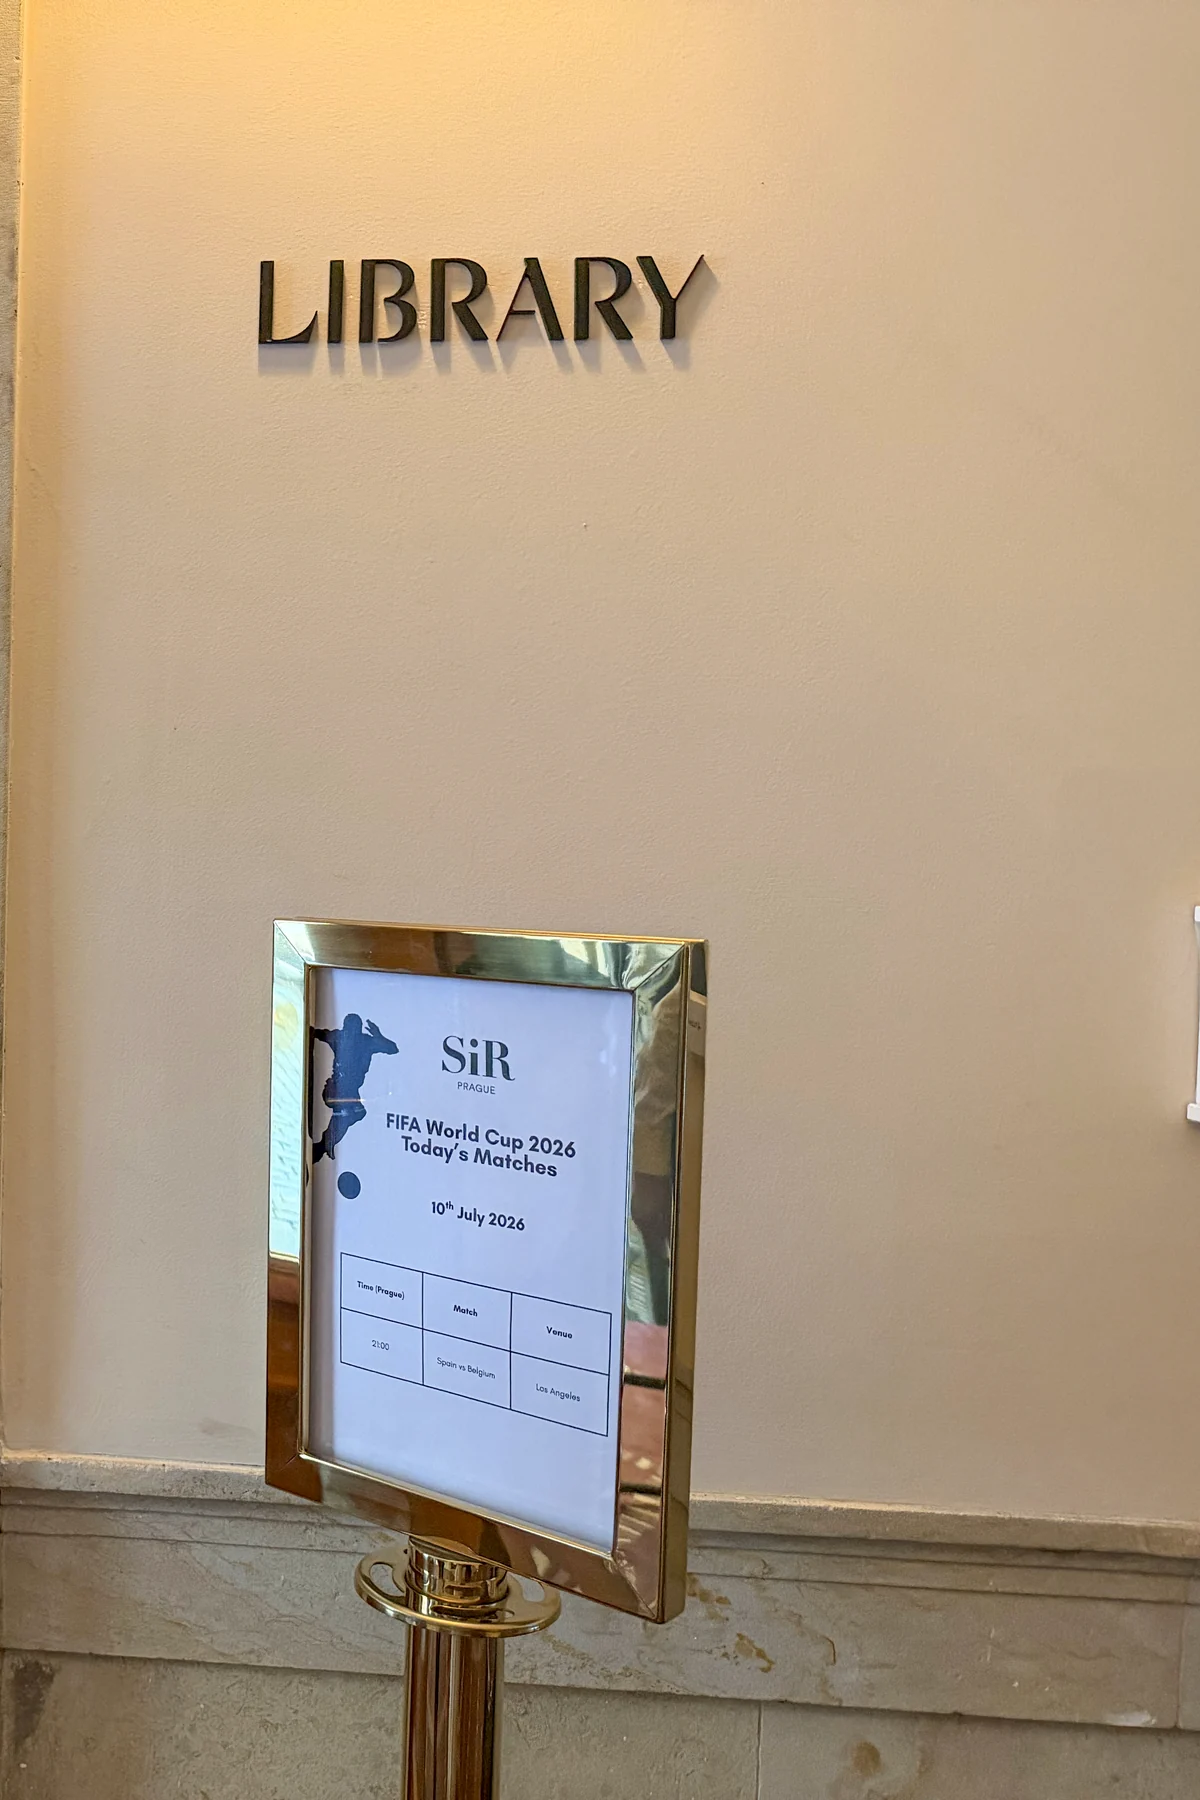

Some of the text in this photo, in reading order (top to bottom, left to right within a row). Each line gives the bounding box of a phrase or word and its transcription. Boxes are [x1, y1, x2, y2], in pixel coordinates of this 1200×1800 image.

[258, 254, 705, 344] LIBRARY
[441, 1035, 516, 1082] SiR
[457, 1081, 496, 1095] PRAGUE
[386, 1112, 577, 1159] FIFA World Cup 2026
[401, 1135, 558, 1177] Today's Matches
[457, 1207, 486, 1228] July
[488, 1212, 526, 1232] 2026
[357, 1280, 405, 1301] Time (Prague)
[453, 1304, 478, 1317] Match
[546, 1325, 573, 1340] Venue
[371, 1339, 390, 1351] 21:00
[436, 1356, 496, 1380] Spain vs Belgium
[535, 1382, 581, 1403] Los Angeles
